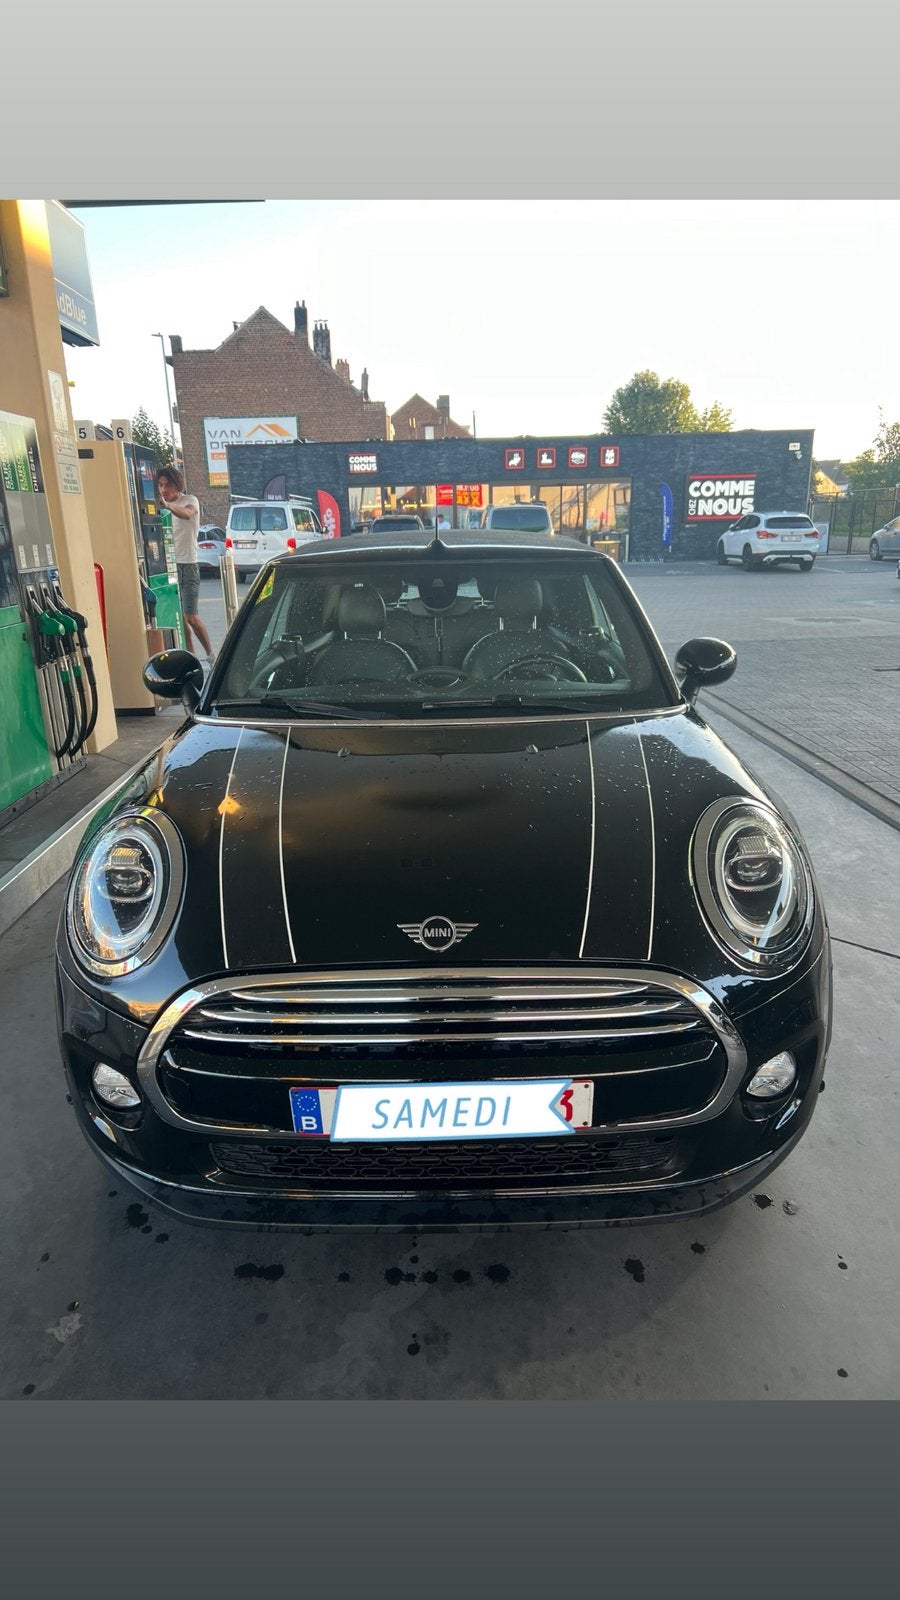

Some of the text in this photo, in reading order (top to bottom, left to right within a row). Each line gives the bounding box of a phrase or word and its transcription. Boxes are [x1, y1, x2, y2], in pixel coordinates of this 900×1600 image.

[78, 428, 87, 439] 5
[116, 427, 124, 438] 6
[208, 430, 241, 438] VAN
[349, 456, 377, 464] COMME
[28, 447, 39, 492] DIESEL
[354, 463, 377, 471] NOUS
[688, 480, 755, 497] COMME
[688, 499, 696, 515] CHEZ
[697, 498, 754, 515] NOUS
[424, 928, 451, 937] MINI
[301, 1115, 318, 1131] B
